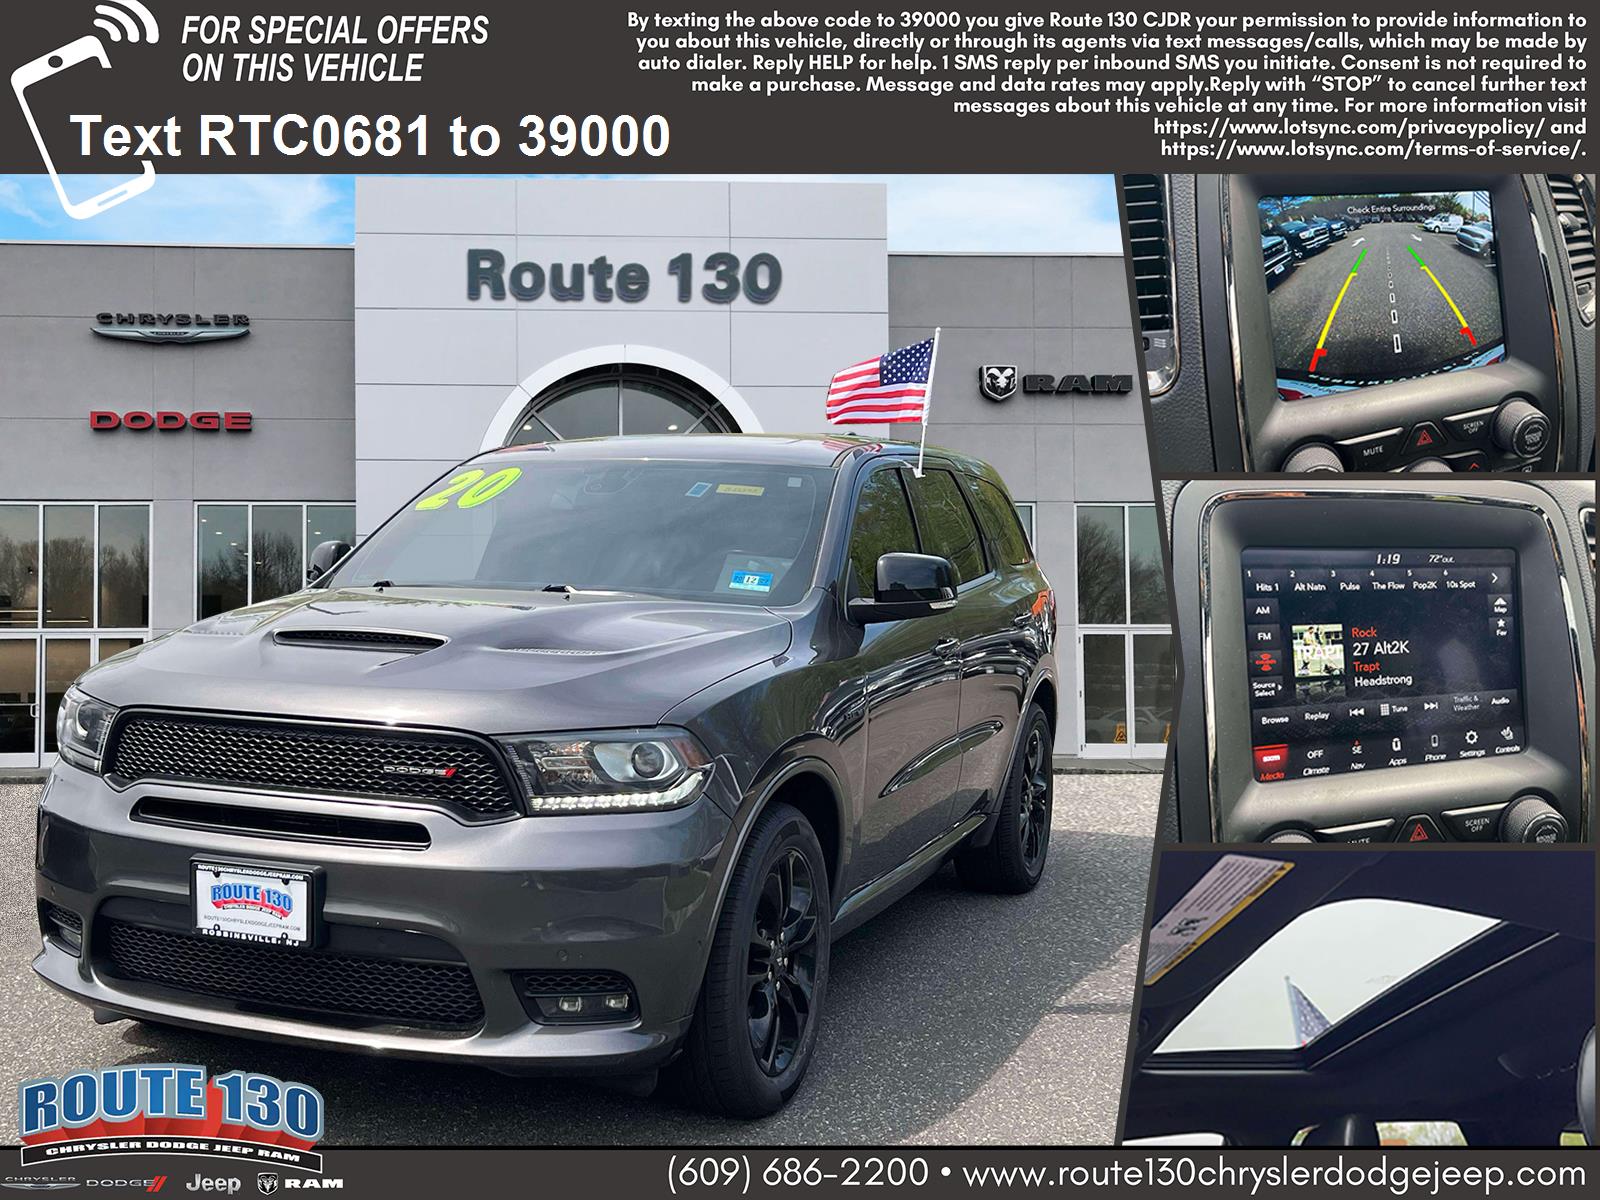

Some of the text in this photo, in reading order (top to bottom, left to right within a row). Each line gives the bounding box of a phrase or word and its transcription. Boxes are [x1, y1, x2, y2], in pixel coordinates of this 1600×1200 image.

[1347, 203, 1436, 214] Check Entire Surroundings
[467, 249, 783, 306] Route 130
[95, 312, 250, 327] CHRYSLER
[1023, 374, 1133, 395] RAM
[90, 411, 252, 431] DODGE
[1463, 420, 1484, 430] SCREEN
[1468, 427, 1479, 435] OFF
[1362, 446, 1384, 456] MUTE
[414, 467, 523, 511] 20
[1376, 553, 1401, 565] 1:19
[1256, 583, 1272, 592] Hits
[1294, 583, 1306, 591] Alt
[1340, 582, 1360, 591] Pulse
[1372, 581, 1406, 590] The Flow
[1412, 581, 1438, 591] Pop2K
[1459, 580, 1476, 590] Spot
[1255, 606, 1271, 615] AM
[1257, 632, 1272, 641] FM
[1351, 626, 1377, 638] Rock
[1352, 640, 1410, 657] 27 Alt2K
[1353, 661, 1381, 674] Trapt
[1252, 682, 1276, 690] Source
[1354, 675, 1413, 688] Headstrong
[1254, 690, 1276, 698] Select
[1490, 696, 1510, 705] Audio
[1391, 705, 1409, 713] Tune
[1453, 703, 1480, 712] Weather
[1261, 716, 1290, 725] Browse
[1304, 711, 1331, 721] Replay
[1459, 749, 1486, 758] Settings
[1495, 744, 1521, 754] Controls
[1306, 749, 1324, 760] OFF
[1424, 753, 1447, 762] Phone
[1350, 762, 1366, 770] Nav
[1388, 758, 1408, 767] Apps
[383, 765, 446, 776] DODGE
[1259, 771, 1285, 782] Media
[1464, 818, 1490, 828] SCREEN
[1470, 825, 1484, 833] OFF
[211, 883, 261, 901] ROUTE
[264, 888, 293, 912] 130
[285, 939, 300, 947] NJ
